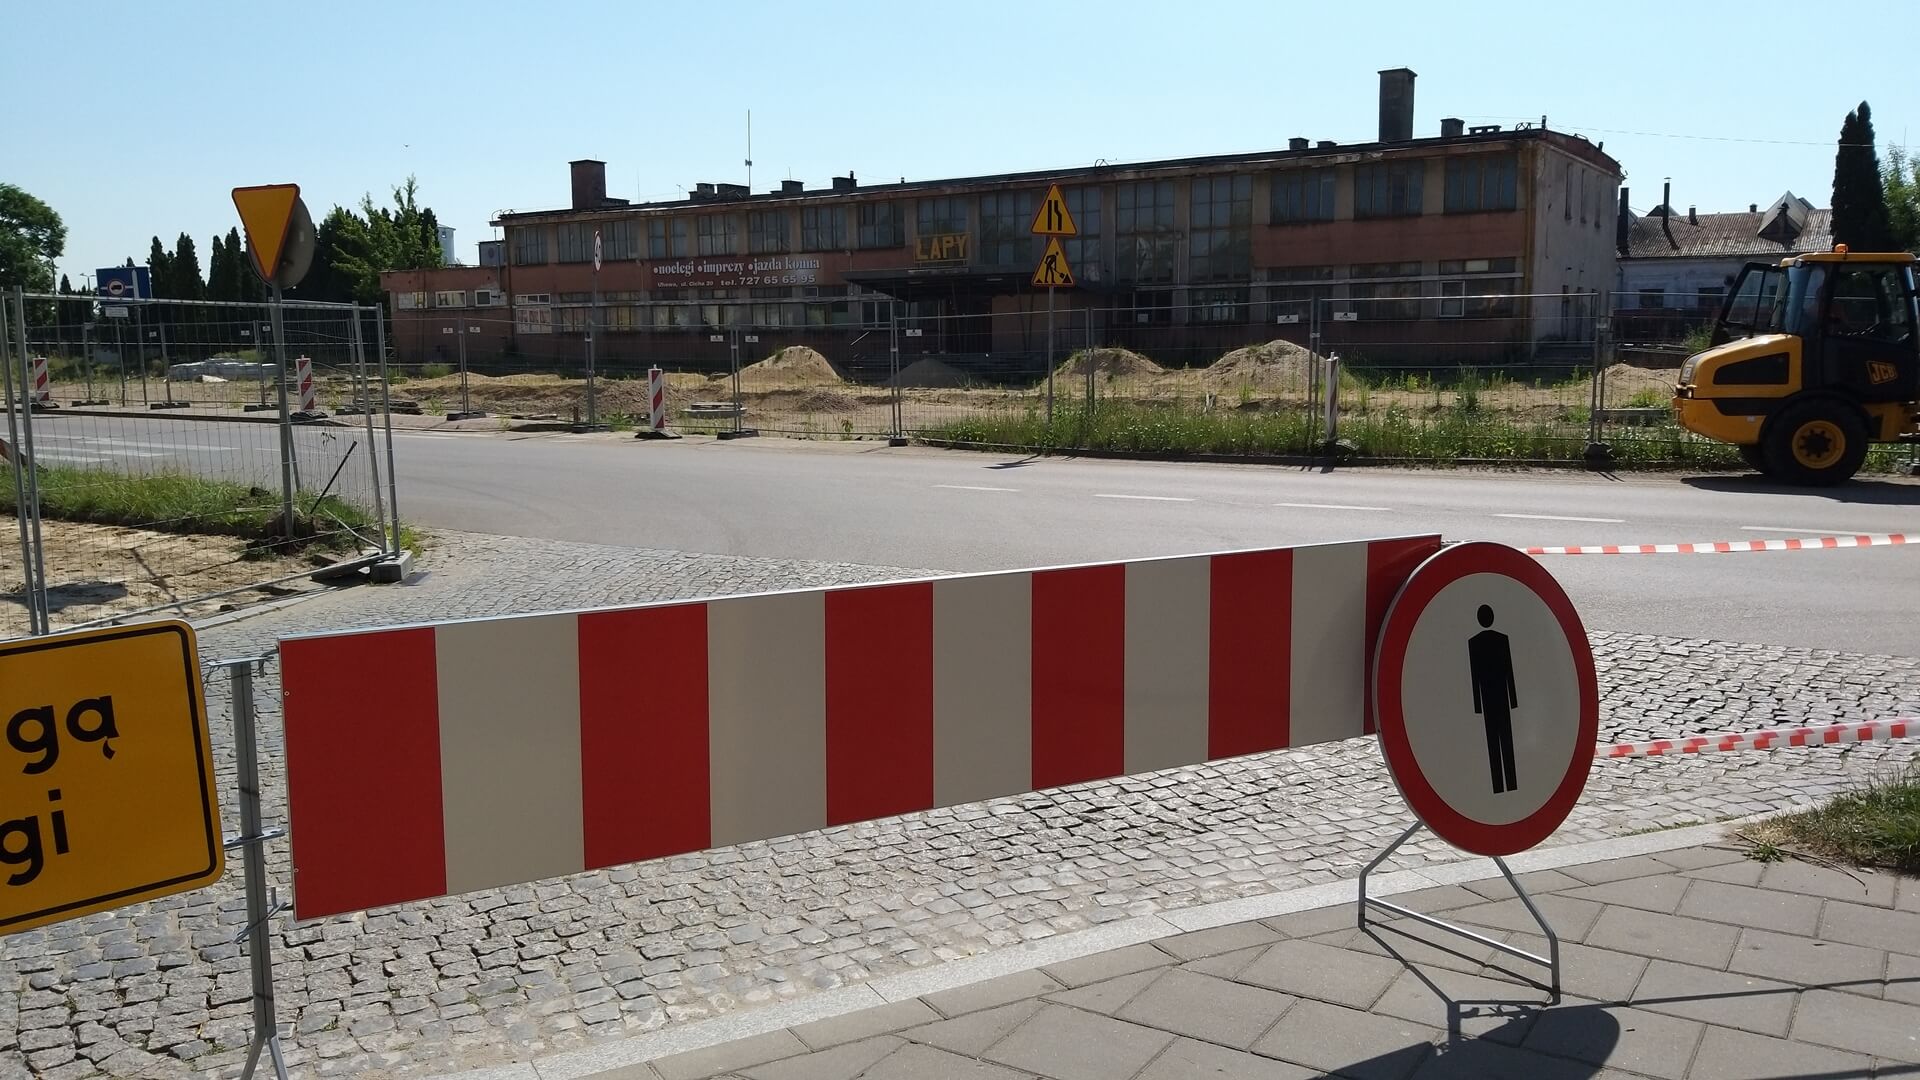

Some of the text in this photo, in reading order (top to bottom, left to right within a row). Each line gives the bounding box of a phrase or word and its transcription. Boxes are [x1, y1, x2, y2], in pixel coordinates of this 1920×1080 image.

[739, 277, 760, 285] 727
[763, 276, 778, 284] 65
[782, 275, 796, 283] 65
[801, 274, 815, 283] 95
[1871, 363, 1896, 381] JCB
[0, 788, 69, 886] gi
